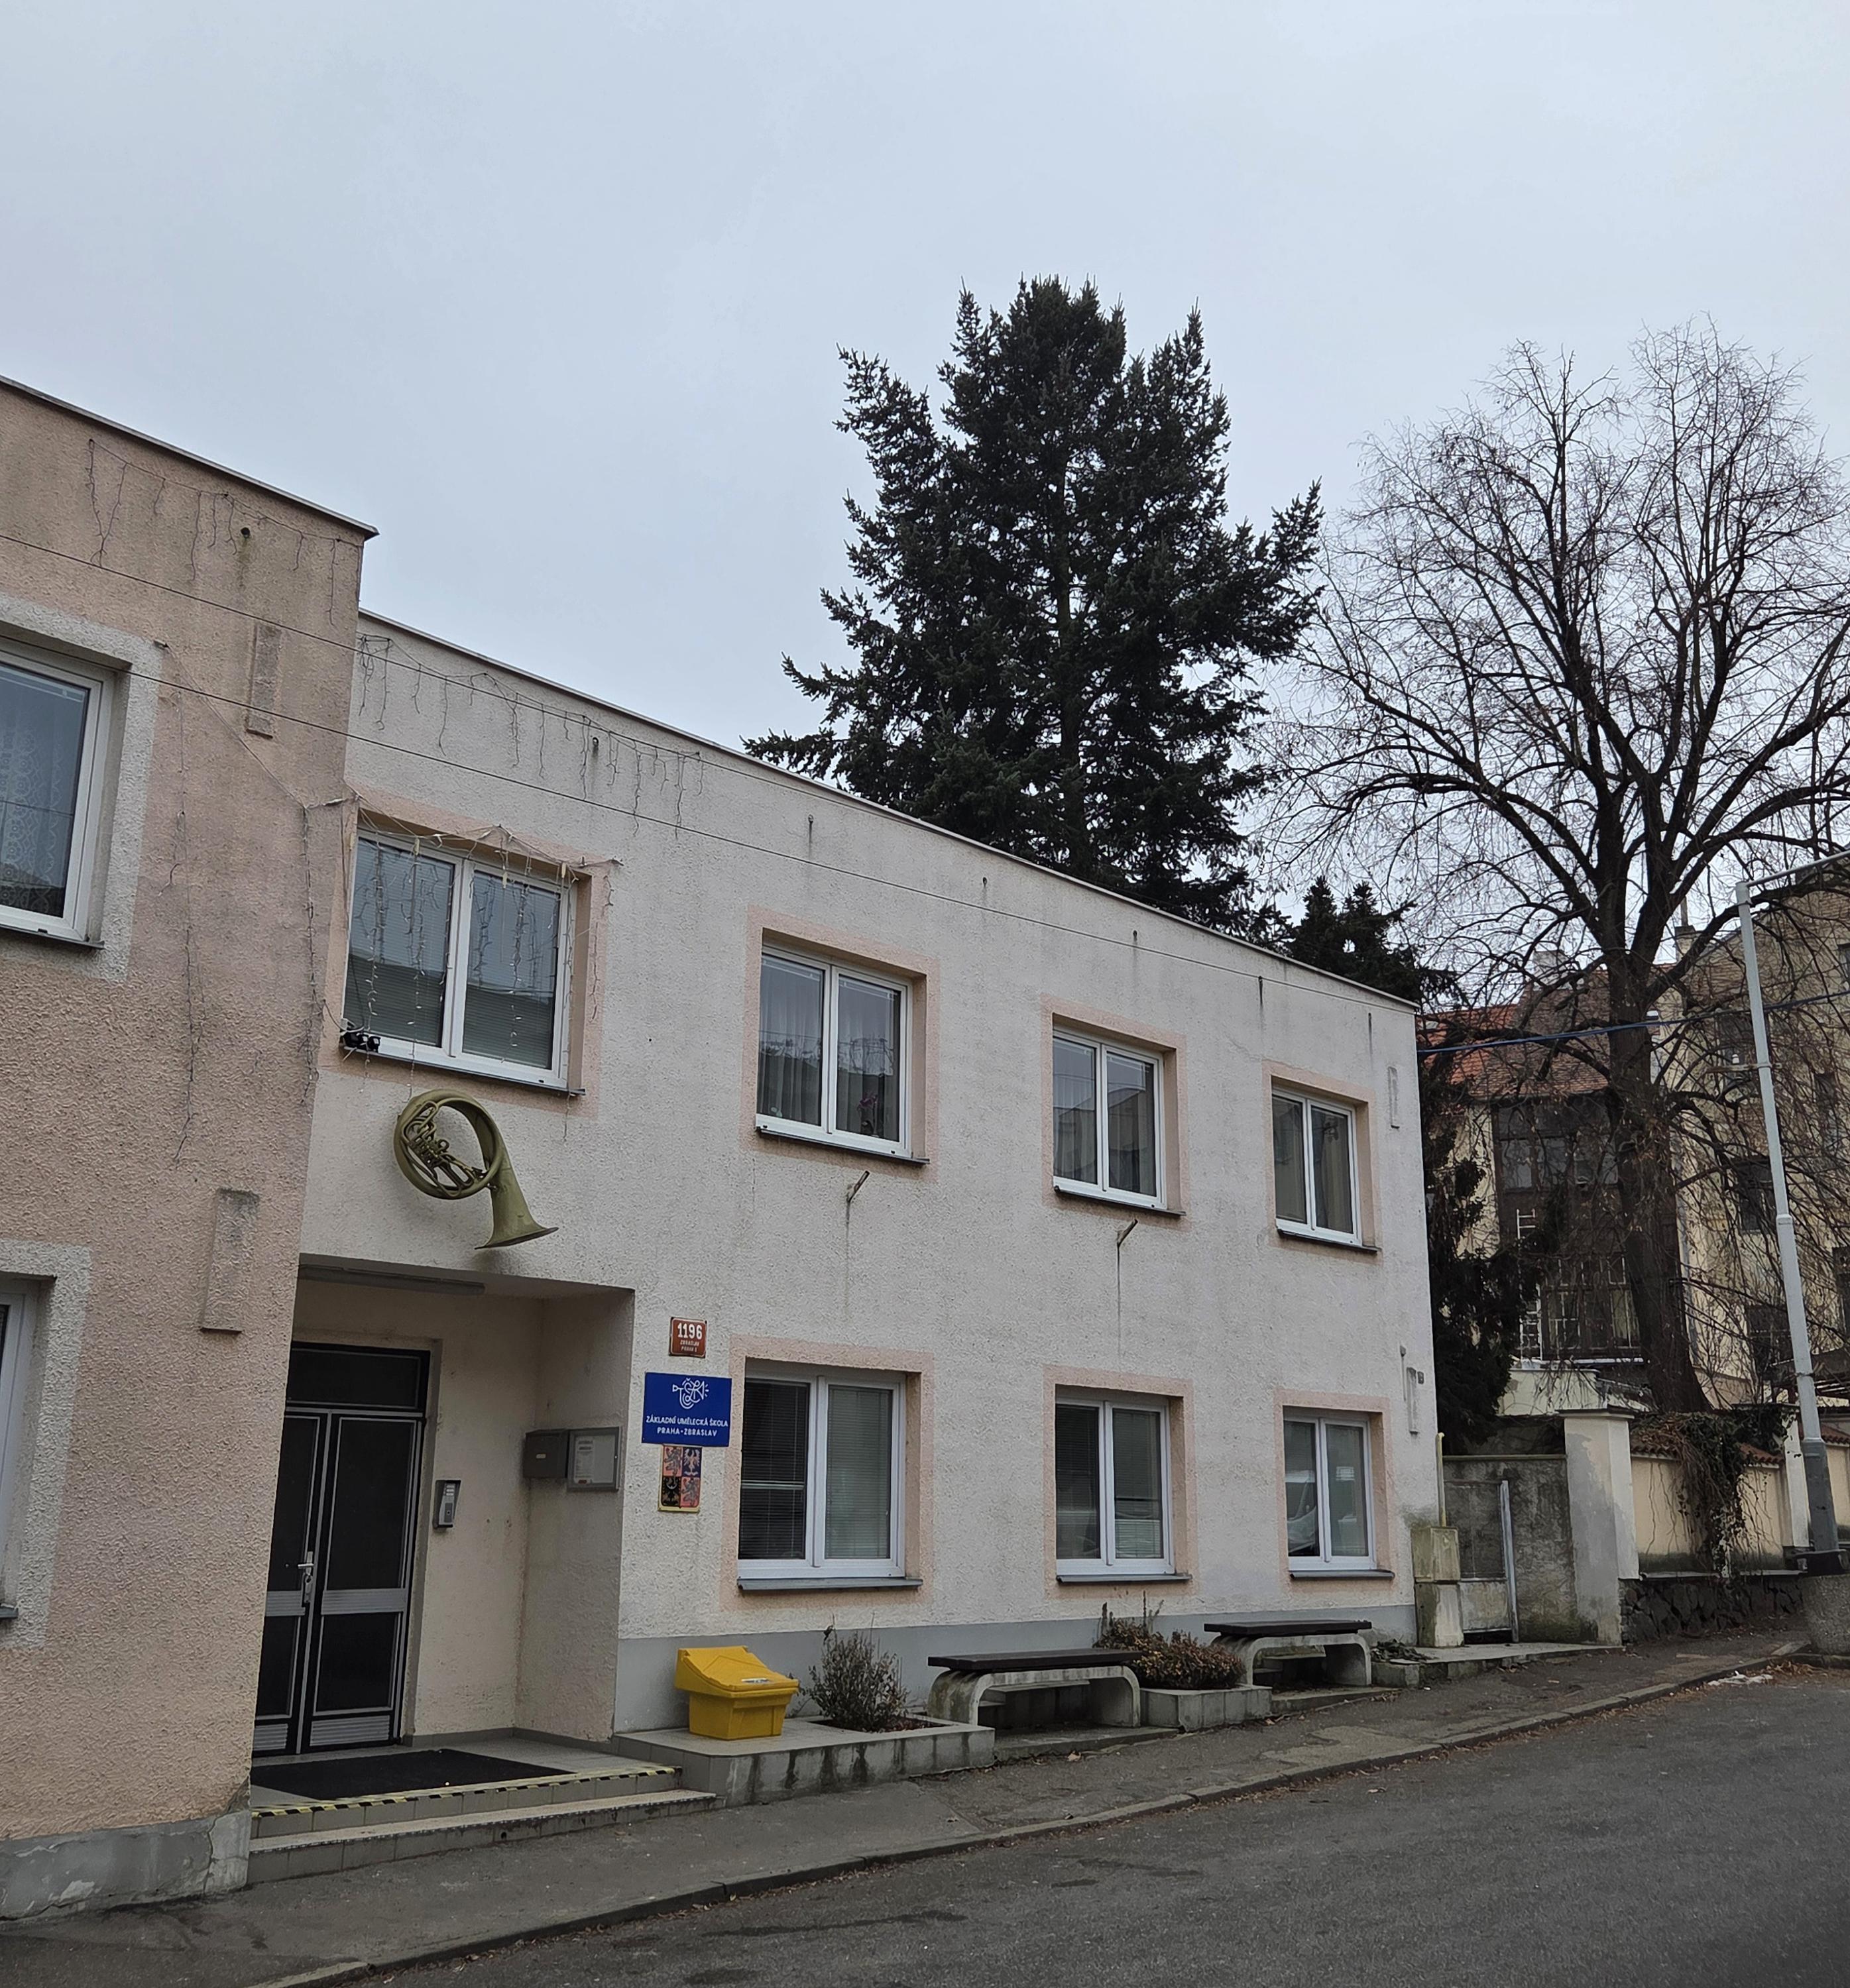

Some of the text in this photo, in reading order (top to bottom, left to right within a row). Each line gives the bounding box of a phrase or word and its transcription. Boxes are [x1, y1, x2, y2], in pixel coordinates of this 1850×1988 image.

[677, 1323, 703, 1340] 1196
[646, 1414, 728, 1427] ZÁKLADNÍ UMĚLECKÁ ŠKOLA
